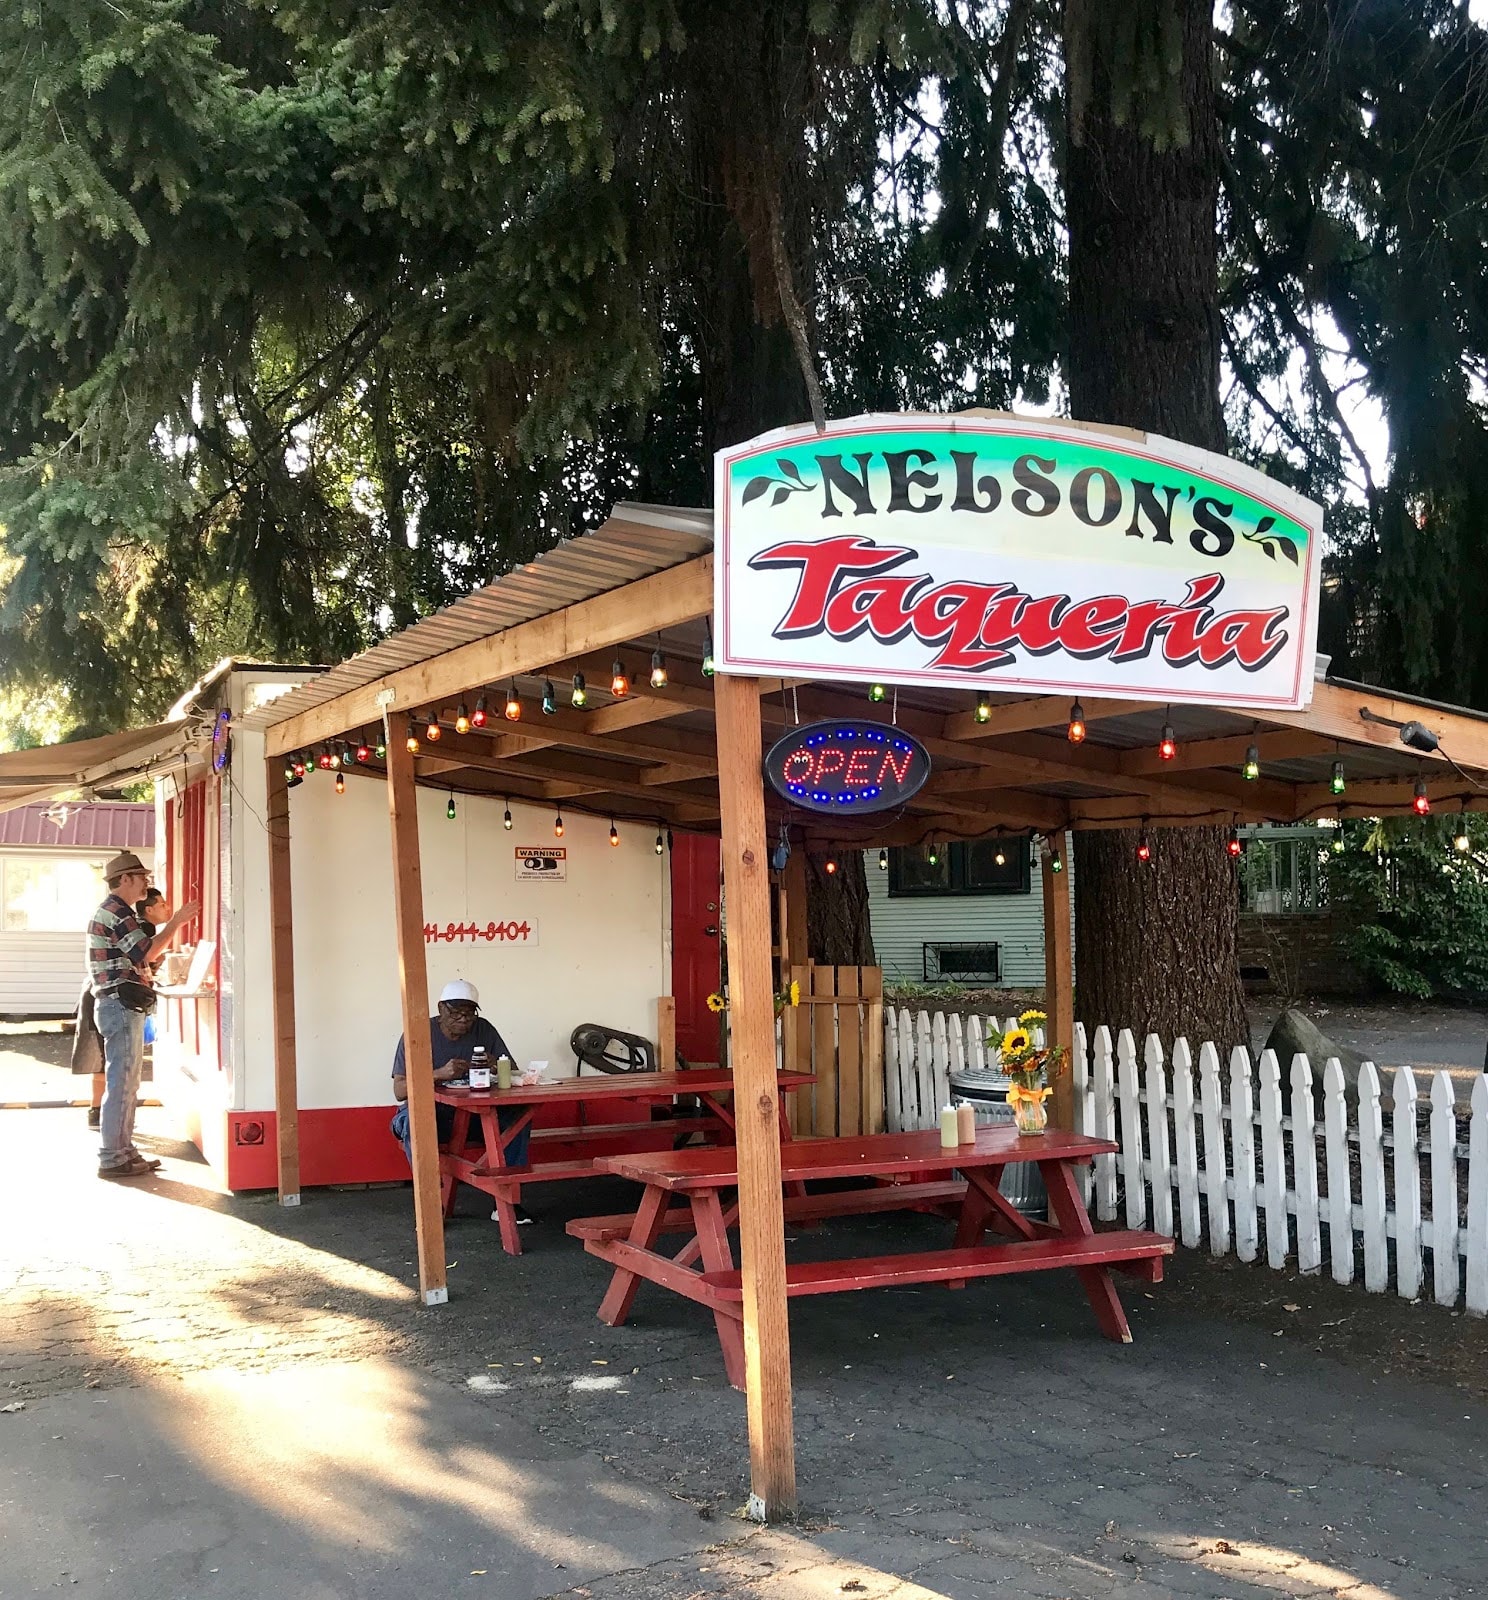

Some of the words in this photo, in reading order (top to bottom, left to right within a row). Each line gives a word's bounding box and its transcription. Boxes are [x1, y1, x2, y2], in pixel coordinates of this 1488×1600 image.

[814, 448, 1234, 558] NELSON'S
[747, 535, 1289, 673] Taquería
[783, 749, 914, 785] OPEN
